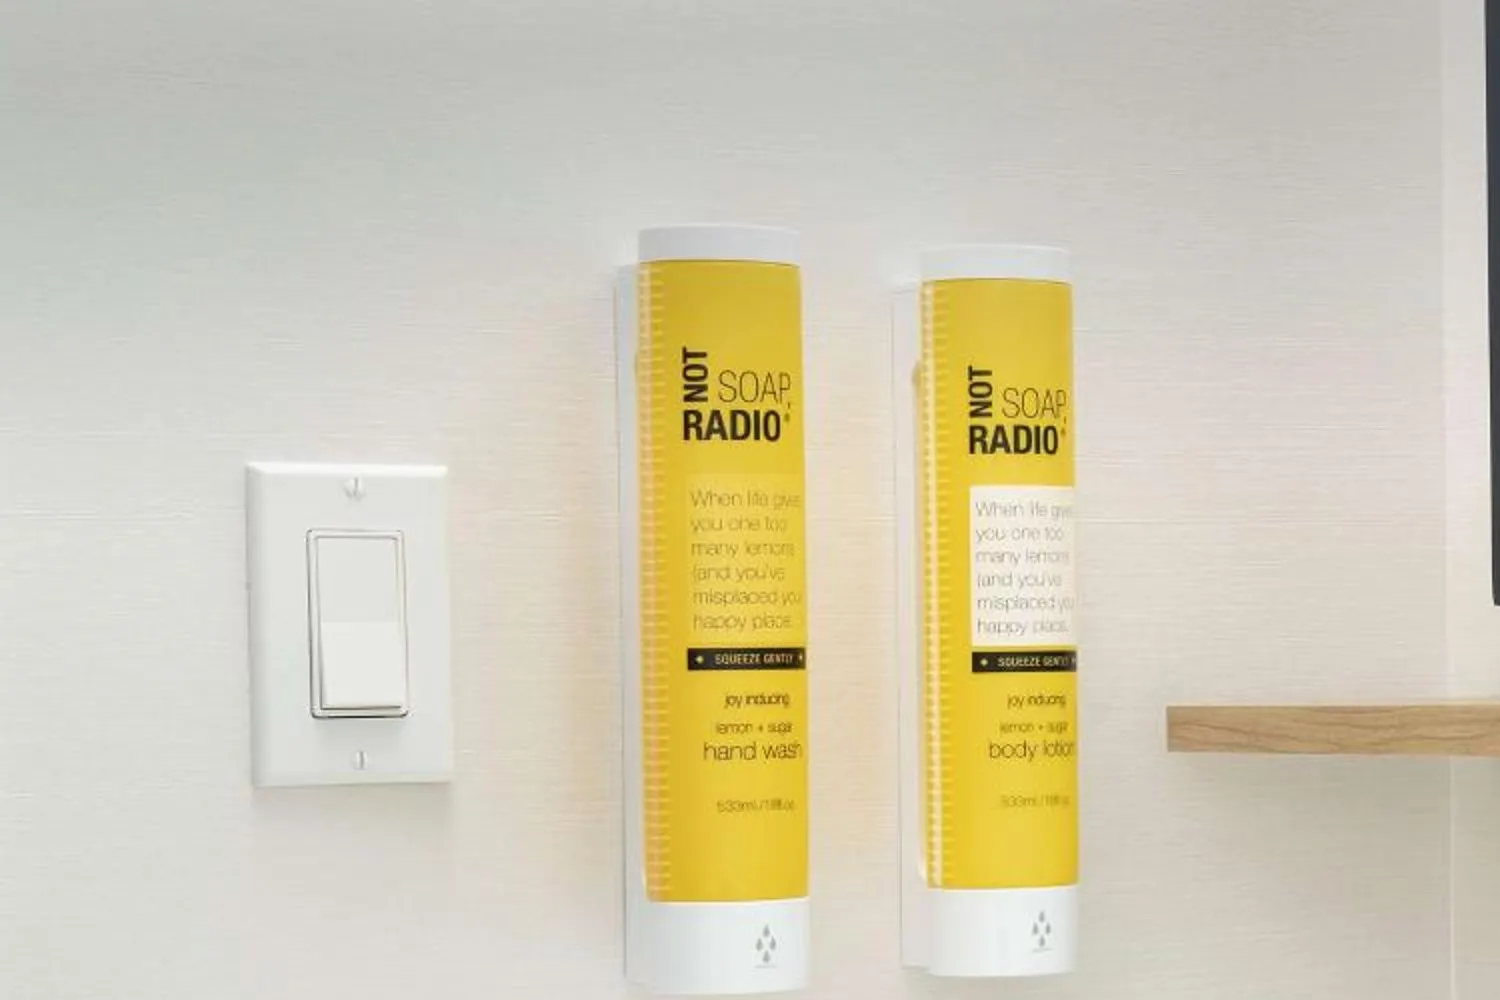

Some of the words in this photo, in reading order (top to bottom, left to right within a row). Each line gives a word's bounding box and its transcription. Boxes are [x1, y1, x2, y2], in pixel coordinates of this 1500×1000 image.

[681, 346, 709, 403] NOT
[967, 365, 993, 418] NOT
[689, 490, 742, 507] When
[747, 489, 769, 507] life
[975, 501, 1025, 518] When
[690, 519, 723, 533] you
[728, 517, 761, 532] one
[765, 515, 788, 533] too
[975, 527, 1006, 543] you
[1011, 527, 1041, 541] one
[1044, 525, 1065, 541] too
[691, 541, 739, 558] many
[975, 550, 1021, 567] many
[692, 588, 777, 607] misplaced
[977, 595, 1056, 614] misplaced
[693, 613, 747, 633] happy
[977, 617, 1028, 637] happy
[714, 652, 761, 665] SQUEEZE
[997, 655, 1041, 668] SQUEEZE
[703, 741, 757, 761] hand
[989, 740, 1038, 762] body
